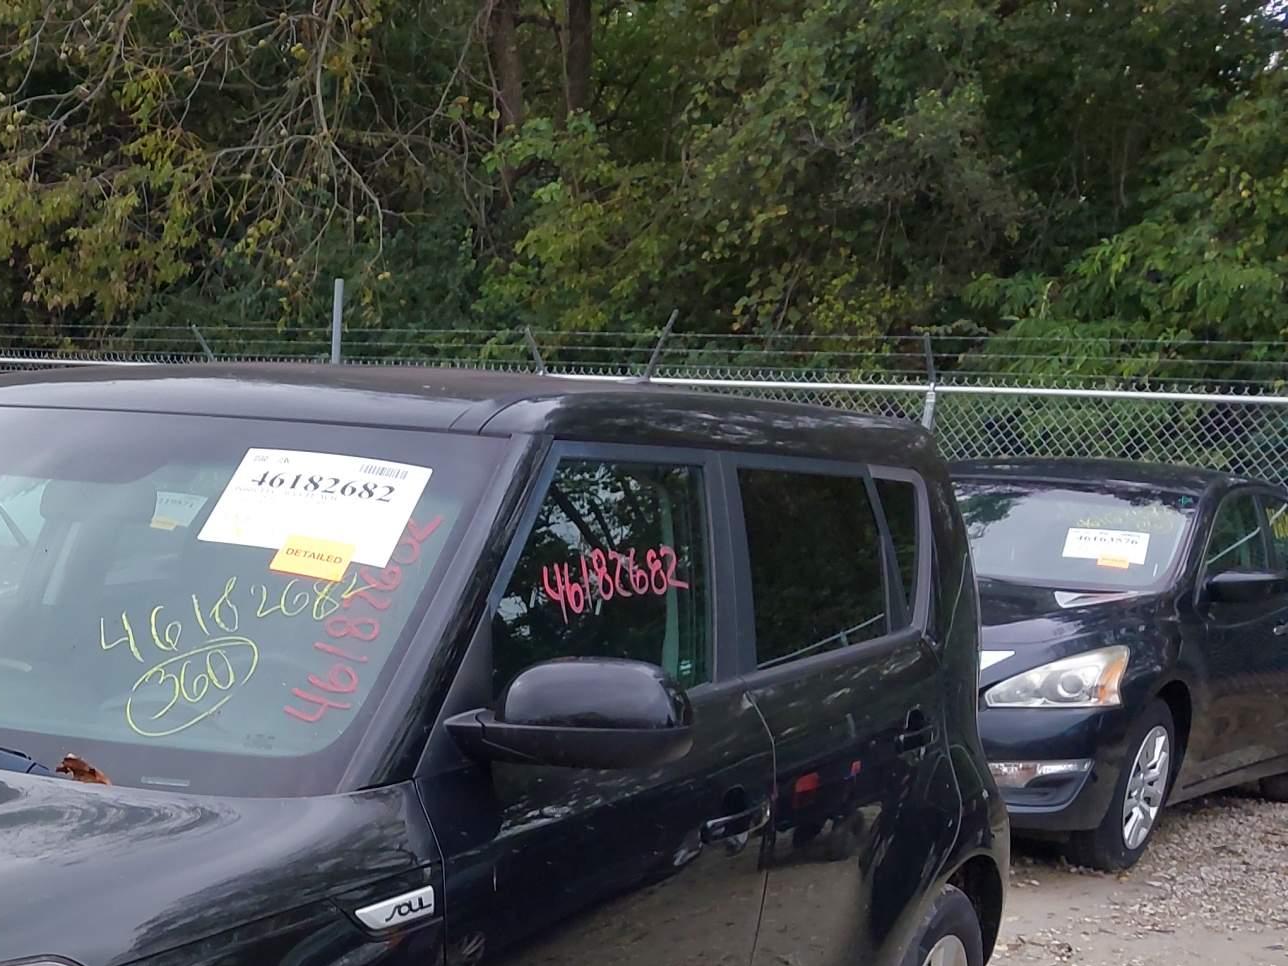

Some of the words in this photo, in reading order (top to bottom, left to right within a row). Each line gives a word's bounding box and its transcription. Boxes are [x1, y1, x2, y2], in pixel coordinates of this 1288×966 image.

[251, 470, 396, 503] 46182682
[285, 547, 343, 565] DETAILED
[543, 544, 689, 624] 46182682
[144, 649, 236, 720] 360
[385, 896, 432, 922] SOUL
